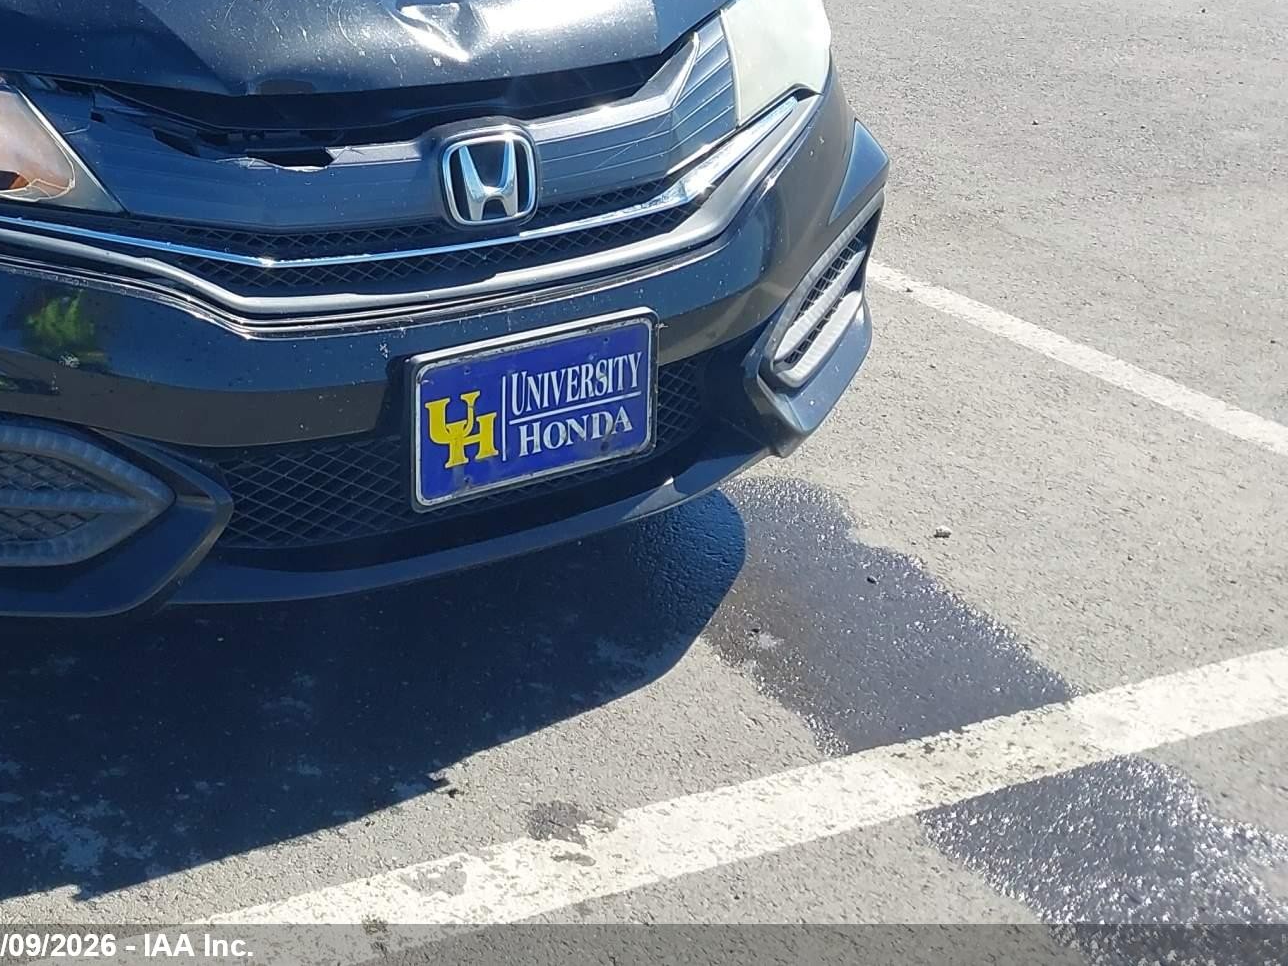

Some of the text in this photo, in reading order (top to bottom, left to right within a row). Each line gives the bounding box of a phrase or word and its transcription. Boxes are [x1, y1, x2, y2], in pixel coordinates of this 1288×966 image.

[512, 352, 642, 416] UNIVERSITY
[425, 390, 499, 468] UH
[519, 406, 633, 458] HONDA
